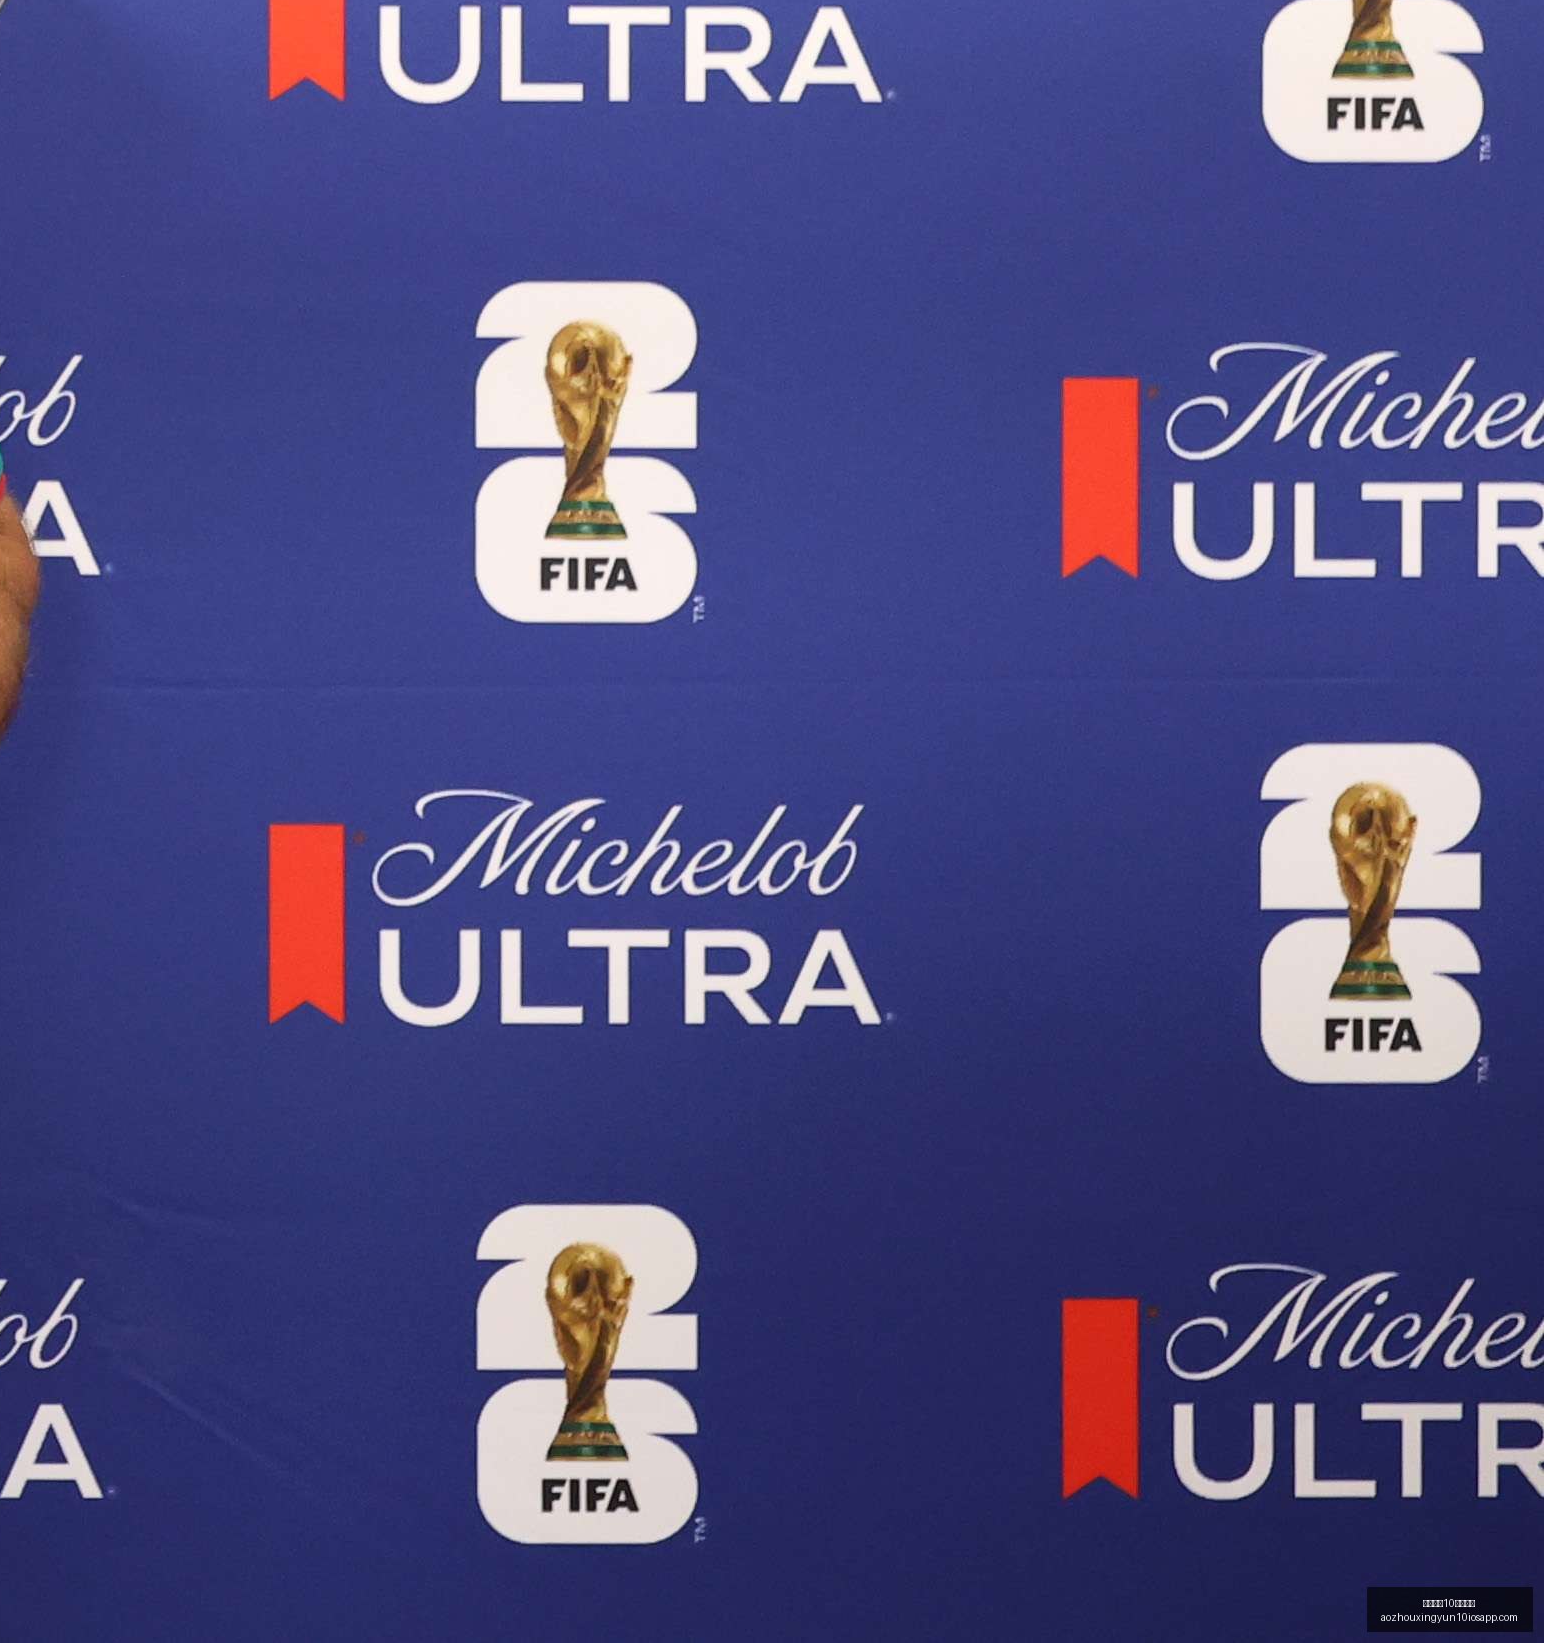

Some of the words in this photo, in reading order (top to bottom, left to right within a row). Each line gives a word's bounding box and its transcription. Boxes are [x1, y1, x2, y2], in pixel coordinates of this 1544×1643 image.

[380, 6, 881, 103] ULTRA
[1328, 98, 1423, 129] FIFA
[1166, 343, 1544, 460] Miche
[541, 558, 636, 590] FIFA
[373, 790, 863, 906] Michelob
[380, 929, 881, 1026] ULTRA
[1326, 1019, 1421, 1051] FIFA
[1166, 1264, 1544, 1380] Miche
[542, 1479, 638, 1512] FIFA
